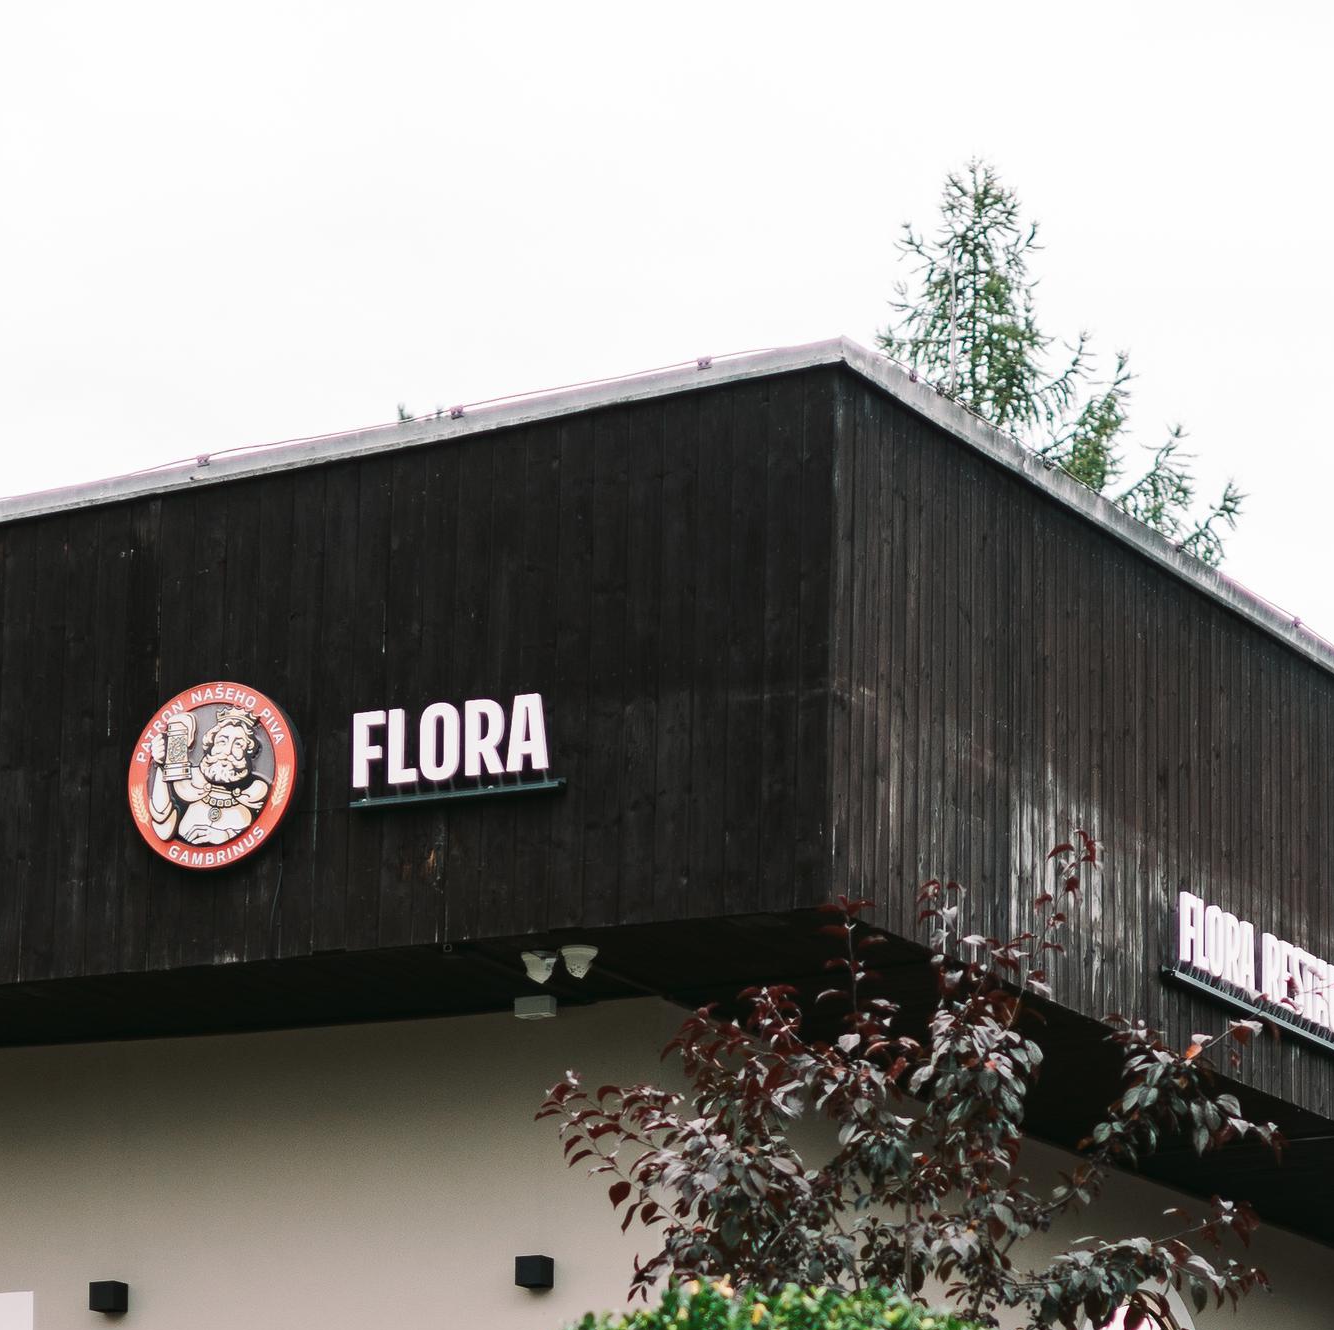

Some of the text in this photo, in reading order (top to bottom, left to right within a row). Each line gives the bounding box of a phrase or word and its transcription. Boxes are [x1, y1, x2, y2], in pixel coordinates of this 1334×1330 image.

[136, 684, 285, 763] PATRON NAŠEHO PIVA
[352, 692, 549, 788] FLORA
[168, 825, 264, 865] GAMBRINUS
[1179, 891, 1256, 991] FLORA
